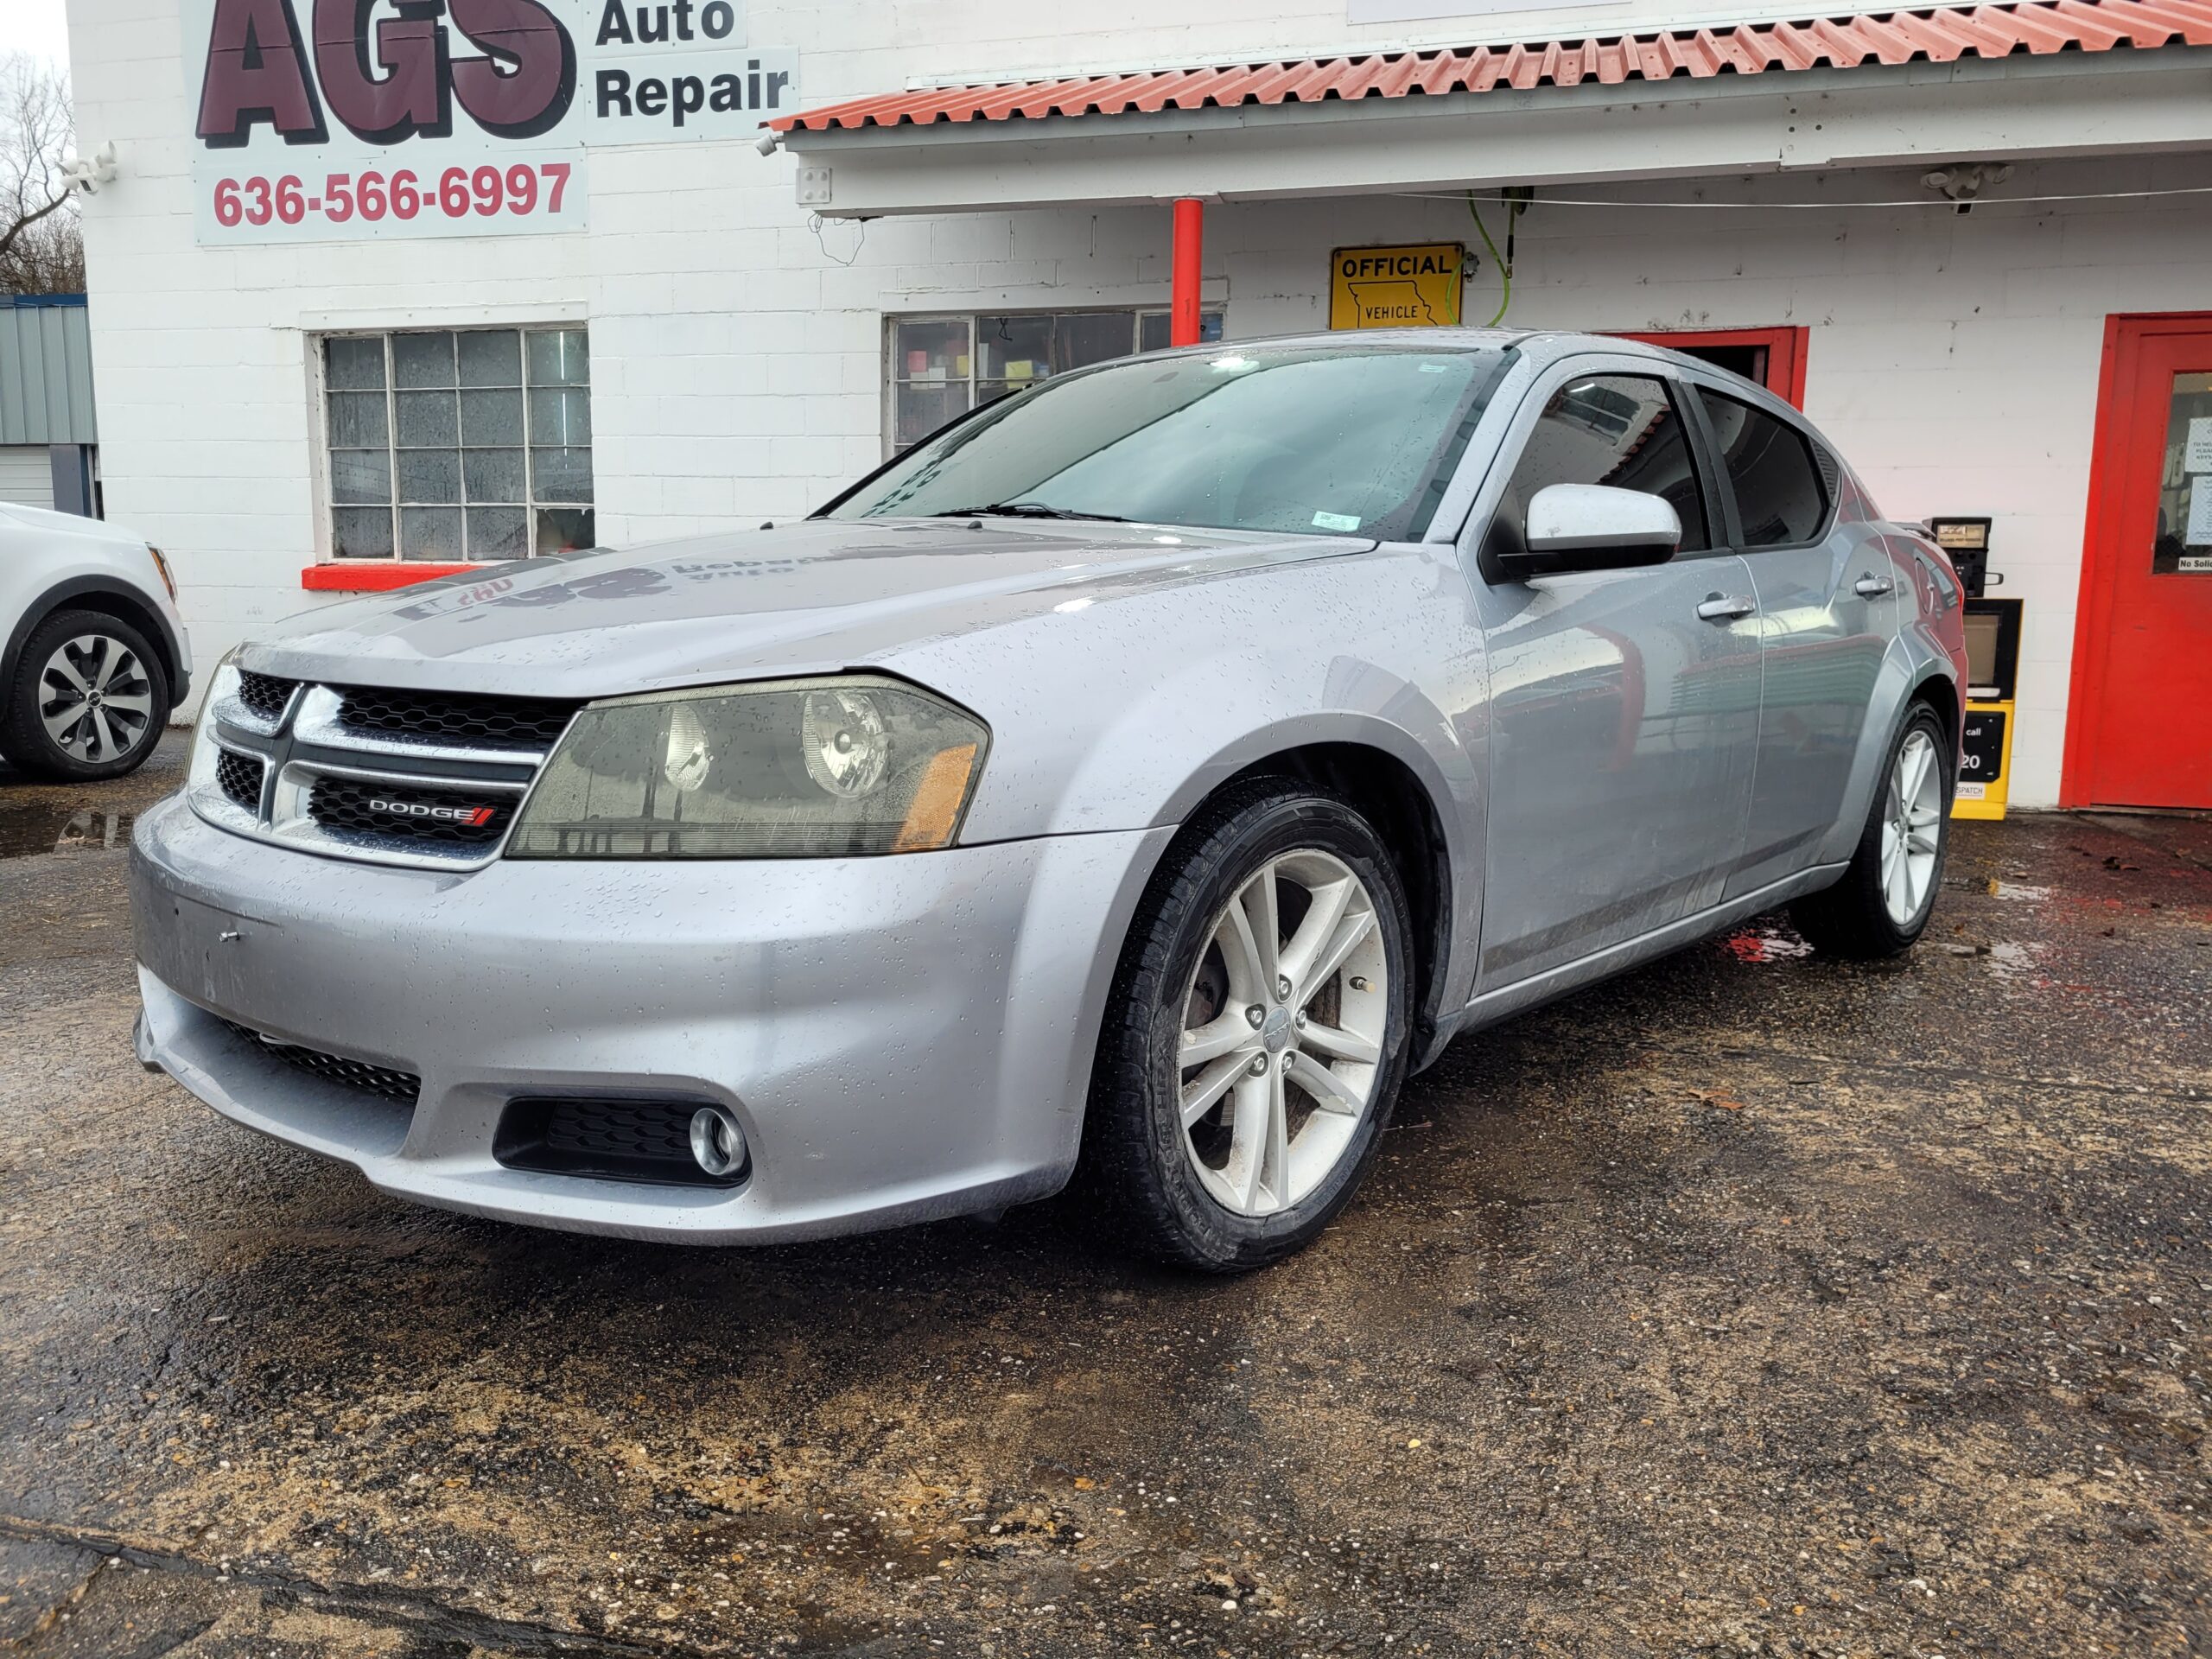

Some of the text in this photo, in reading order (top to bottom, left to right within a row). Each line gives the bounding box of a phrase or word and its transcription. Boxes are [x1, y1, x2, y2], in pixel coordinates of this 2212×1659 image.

[595, 0, 734, 46] Auto
[195, 0, 577, 149] AGS
[596, 59, 789, 128] Repair
[213, 162, 571, 227] 636-566-6997
[1342, 255, 1452, 278] OFFICIAL
[1365, 305, 1418, 320] VEHICLE
[2180, 559, 2191, 568] No
[1966, 728, 1981, 736] call
[1961, 754, 1980, 769] 20
[369, 799, 474, 821] DODGE
